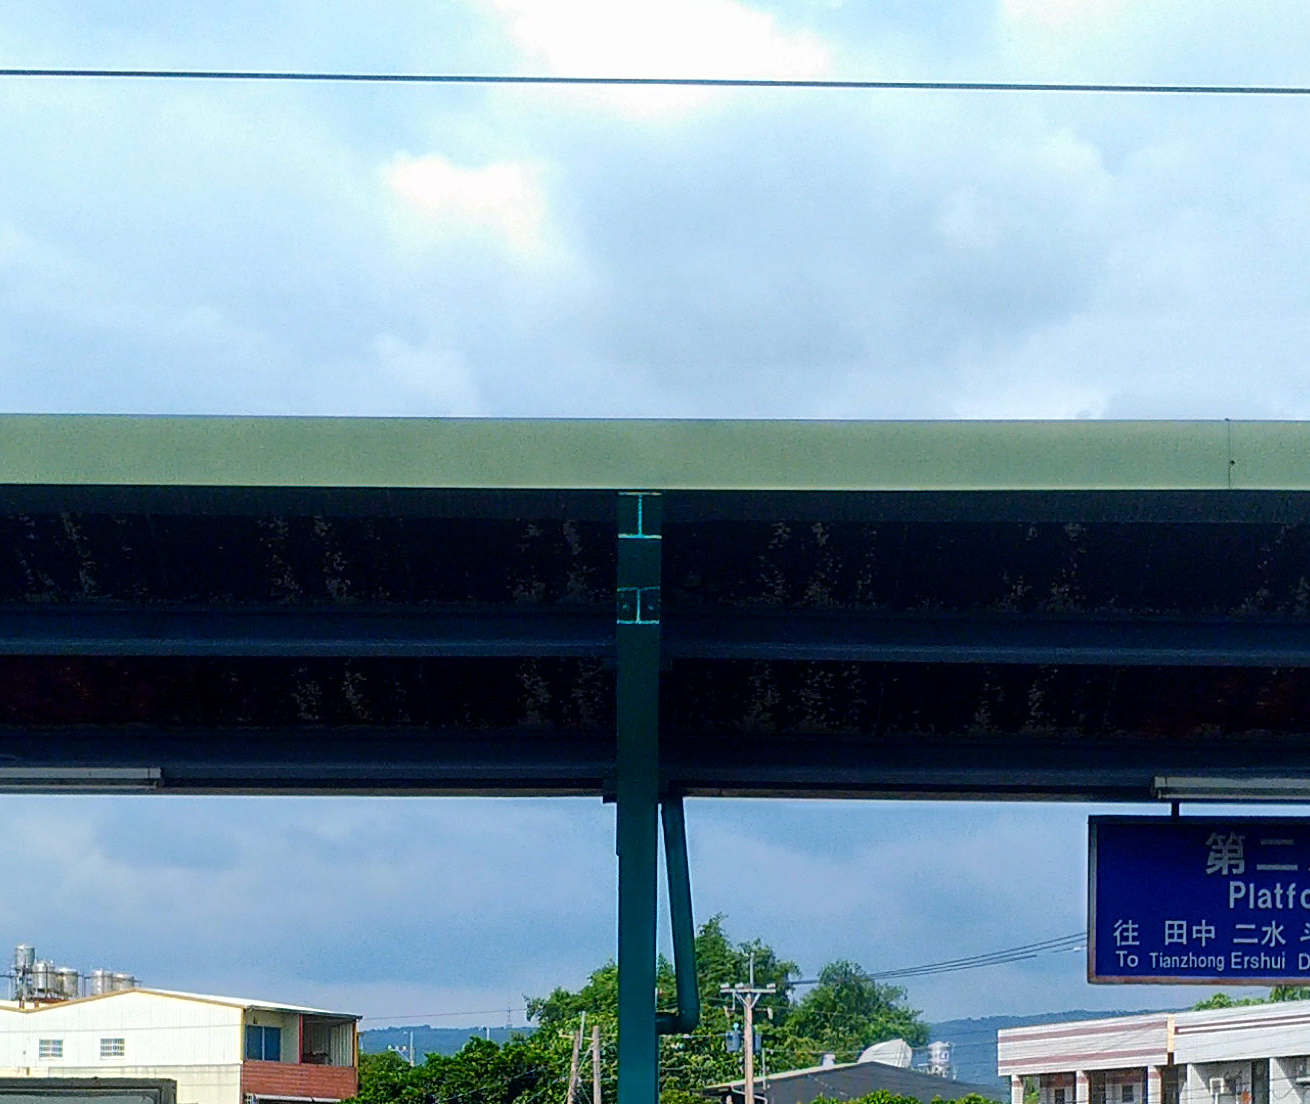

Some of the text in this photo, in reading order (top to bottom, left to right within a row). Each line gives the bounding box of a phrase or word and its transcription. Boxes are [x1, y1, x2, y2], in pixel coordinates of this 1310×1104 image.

[1114, 920, 1139, 946] 往
[1165, 920, 1215, 946] 田中
[1234, 921, 1286, 947] 二水
[1116, 951, 1138, 967] To
[1149, 952, 1224, 971] Tianzhong
[1231, 952, 1285, 969] Ershui
